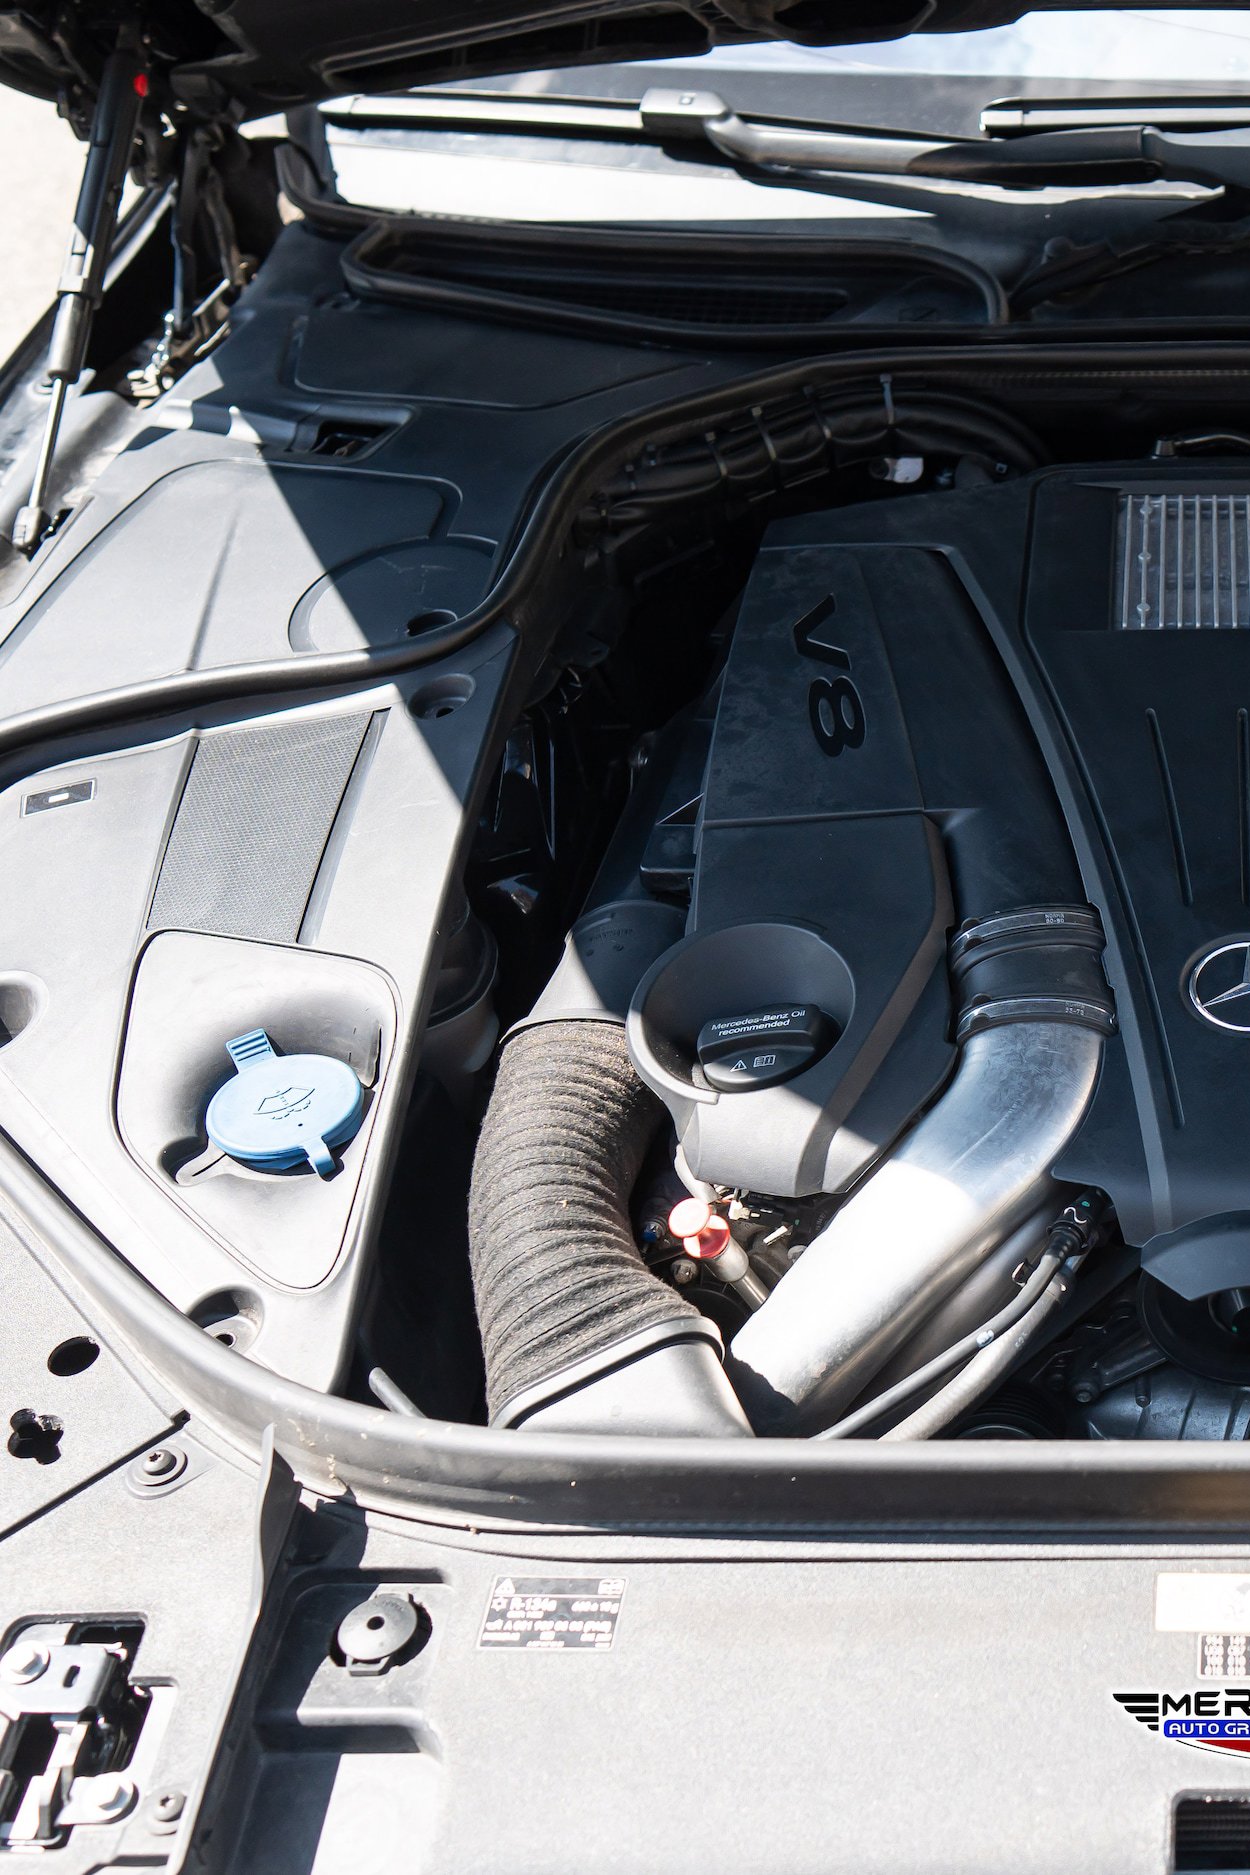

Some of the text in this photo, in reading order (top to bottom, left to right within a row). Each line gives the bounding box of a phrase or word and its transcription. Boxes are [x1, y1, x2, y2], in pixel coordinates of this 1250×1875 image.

[793, 592, 867, 758] V8
[711, 1010, 806, 1031] Mercedes-Benz Oil
[718, 1019, 791, 1036] recommended
